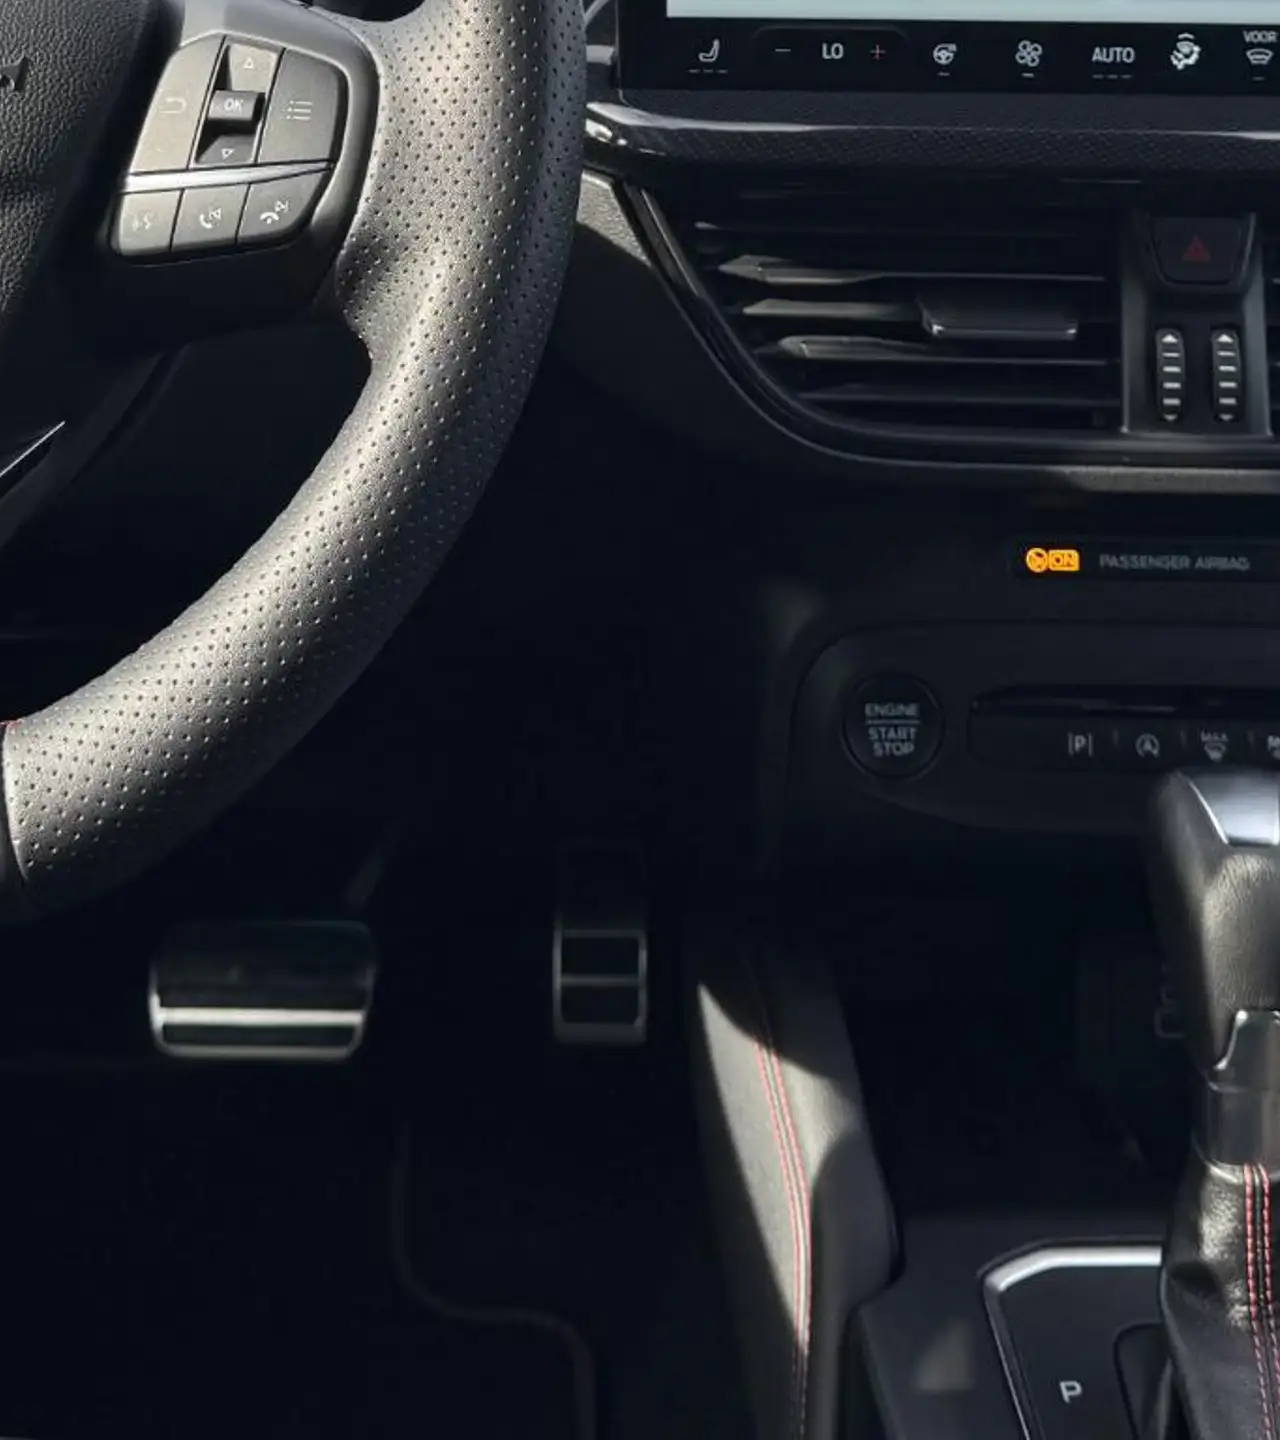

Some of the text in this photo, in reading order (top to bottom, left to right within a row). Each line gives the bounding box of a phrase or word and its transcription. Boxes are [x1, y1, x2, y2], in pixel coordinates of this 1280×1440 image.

[1243, 30, 1278, 44] VOOR
[822, 43, 844, 60] LO
[1091, 46, 1135, 64] AUTO
[224, 98, 244, 112] OK
[1099, 553, 1191, 571] PASSENGER
[1194, 555, 1251, 571] AIRBAG
[864, 702, 919, 717] ENGINE
[868, 726, 917, 740] START
[872, 741, 916, 757] STOP
[1060, 1381, 1082, 1403] P
